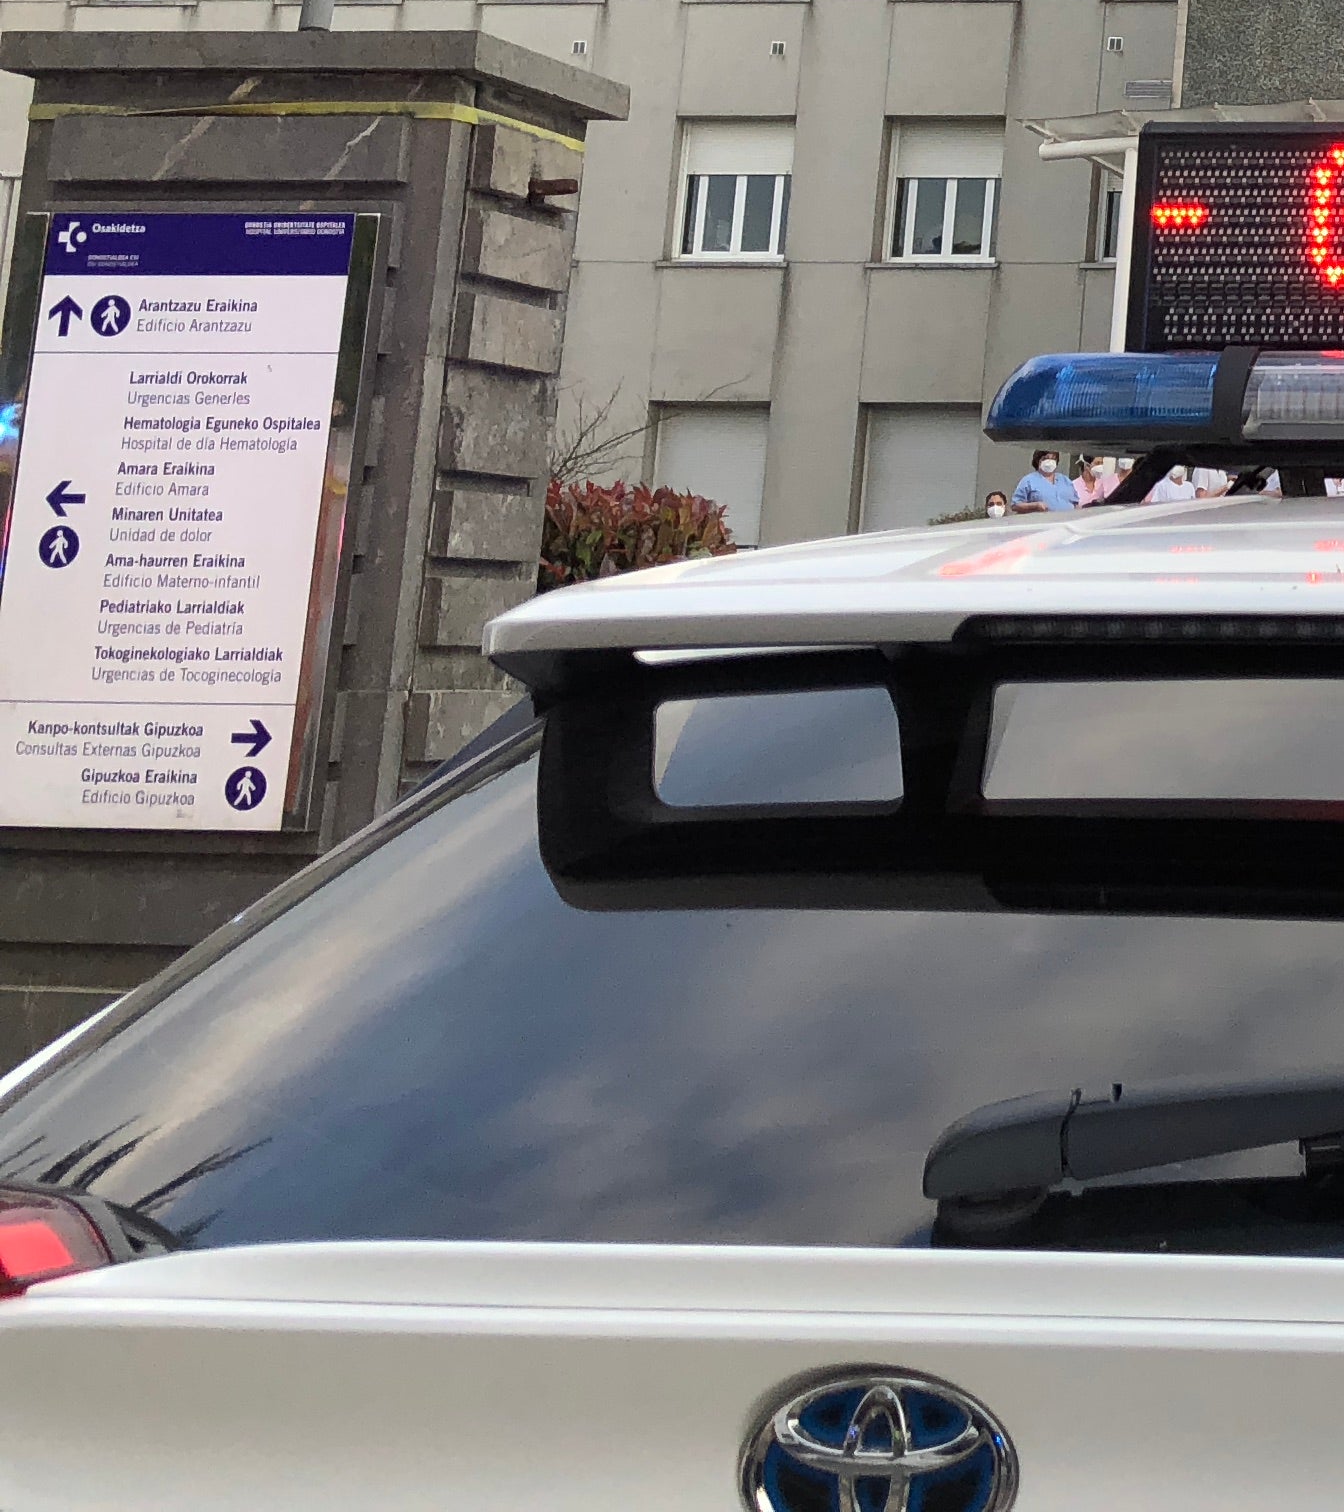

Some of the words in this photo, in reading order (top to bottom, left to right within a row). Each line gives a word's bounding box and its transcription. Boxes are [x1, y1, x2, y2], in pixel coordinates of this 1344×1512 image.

[92, 224, 146, 234] Osakidetza
[139, 299, 201, 312] Arantzazu
[206, 299, 257, 312] Eraikina
[137, 319, 185, 332] Edificio
[189, 319, 251, 332] Arantzazu
[130, 371, 182, 384] Larrialdi
[187, 371, 247, 384] Orokorrak
[128, 391, 190, 407] Urgencias
[124, 416, 200, 433] Hematologia
[206, 417, 258, 433] Eguneko
[263, 417, 320, 433] Ospitalea
[121, 437, 172, 453] Hospital
[177, 437, 191, 450] de
[117, 462, 158, 475] Amara
[163, 462, 214, 475] Eraikina
[116, 482, 163, 495] Edificio
[168, 482, 208, 496] Amara
[112, 507, 163, 521] Minaren
[169, 508, 222, 521] Unitatea
[110, 528, 155, 541] Unidad
[160, 529, 175, 541] de
[180, 528, 212, 542] dolor
[104, 553, 188, 567] Ama-haurren
[193, 554, 245, 568] Eraikina
[104, 574, 152, 587] Edificio
[157, 574, 260, 588] Materno-infantil
[100, 599, 171, 613] Pediatriako
[176, 600, 244, 614] Larrialdiak
[98, 620, 160, 637] Urgencias
[166, 621, 180, 635] de
[95, 646, 210, 663] Tokoginekologiako
[215, 647, 283, 661] Larrialdiak
[92, 667, 154, 683] Urgencias
[160, 668, 175, 681] de
[28, 720, 139, 737] Kanpo-kontsultak
[144, 722, 203, 739] Gipuzkoa
[16, 741, 77, 755] Consultas
[83, 742, 136, 757] Externas
[142, 743, 200, 760] Gipuzkoa
[81, 768, 140, 785] Gipuzkoa
[145, 769, 197, 784] Eraikina
[82, 789, 130, 804] Edificio
[136, 790, 194, 807] Gipuzkoa
